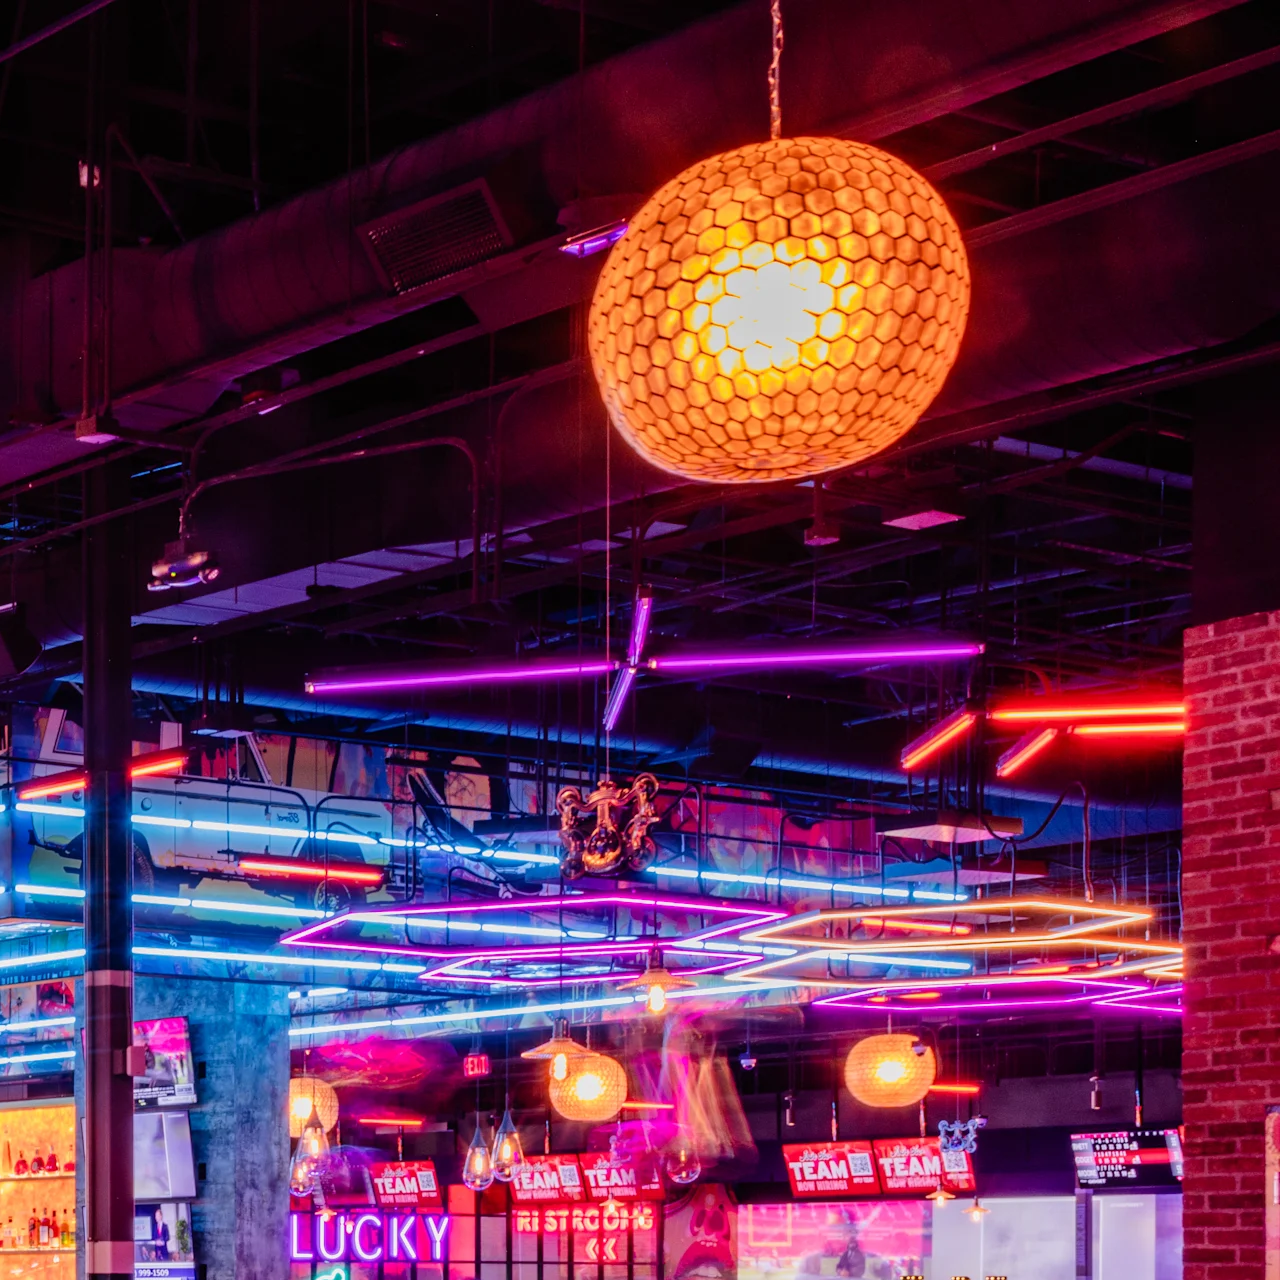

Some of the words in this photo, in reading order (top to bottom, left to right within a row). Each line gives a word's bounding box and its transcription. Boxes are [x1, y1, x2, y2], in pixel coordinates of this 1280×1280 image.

[468, 1056, 487, 1074] EXIT
[789, 1160, 849, 1181] TEAM
[879, 1156, 941, 1177] TEAM
[374, 1177, 419, 1194] TEAM
[511, 1172, 559, 1191] TEAM
[584, 1169, 637, 1187] TEAM
[797, 1181, 815, 1192] NOW
[291, 1213, 450, 1260] LUCKY
